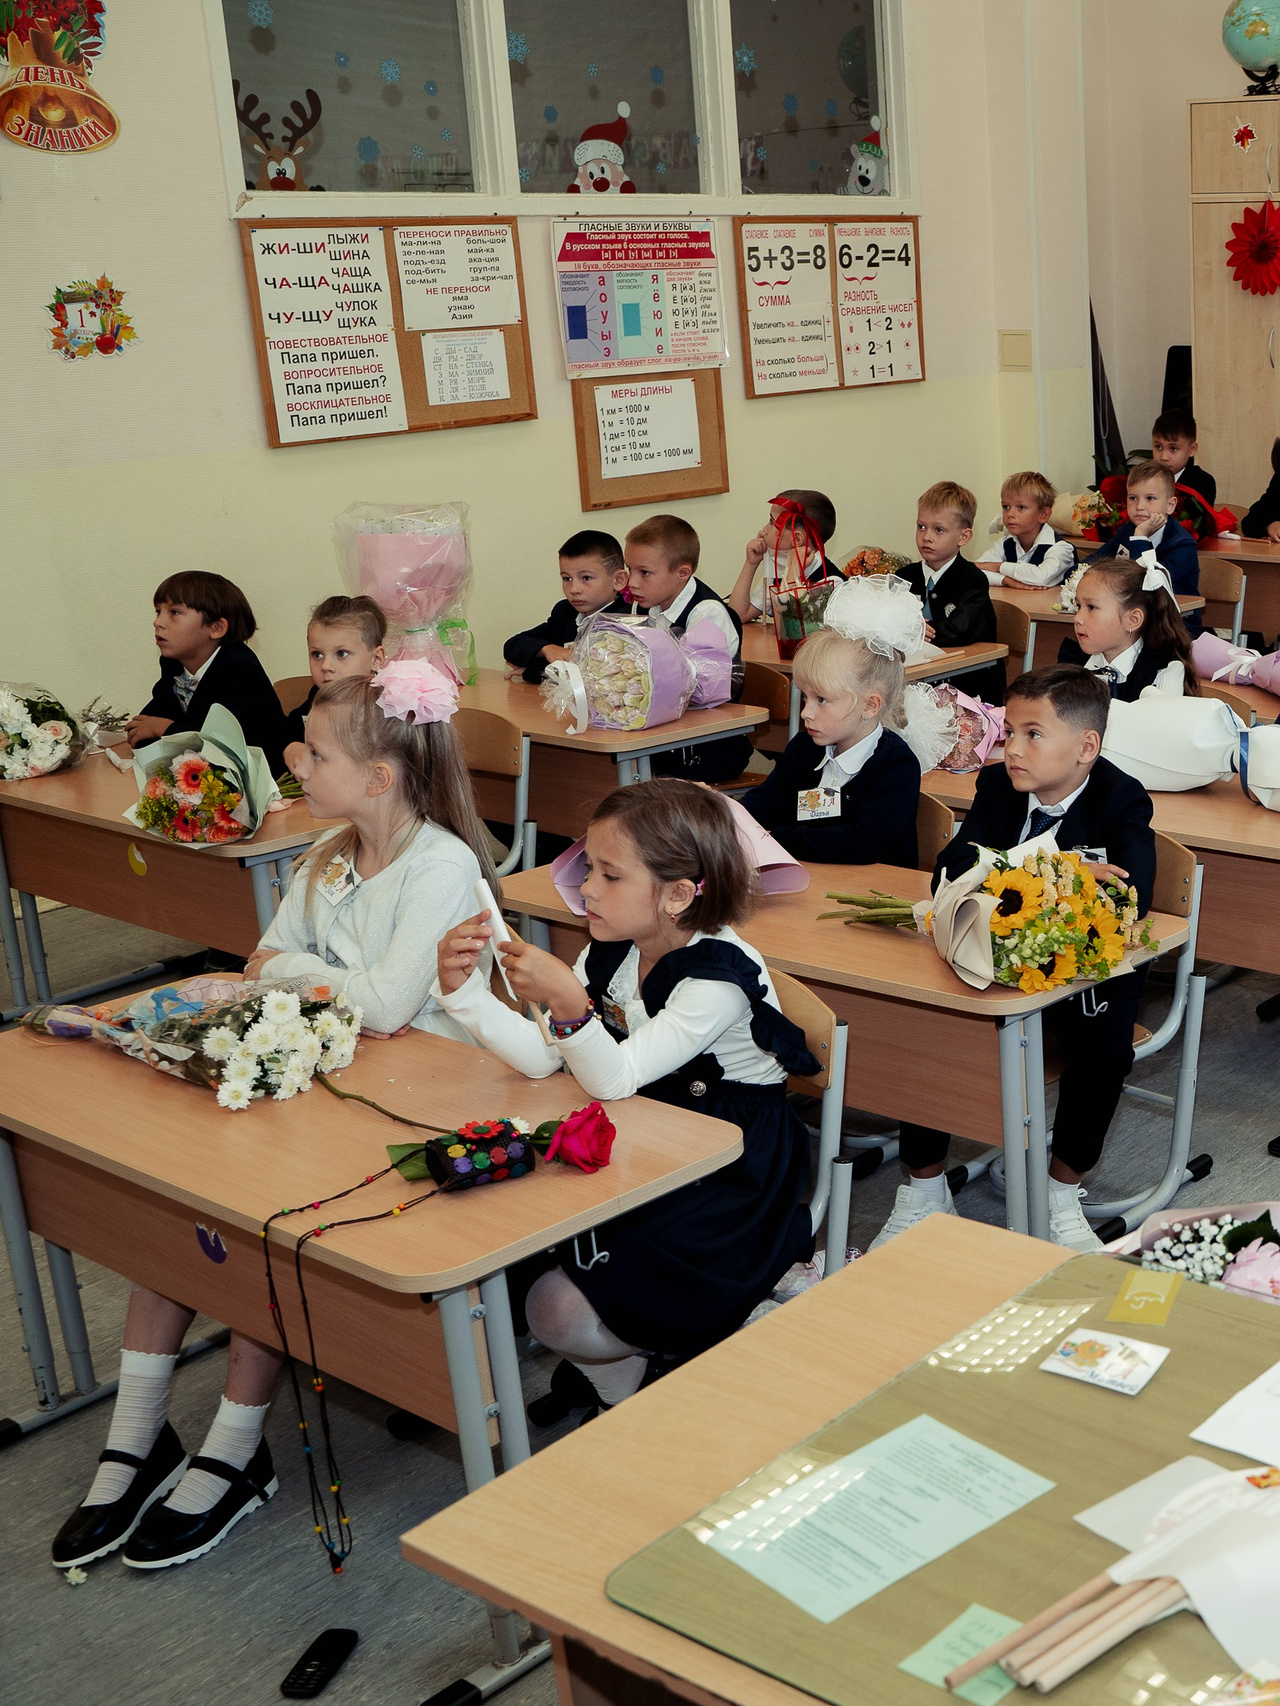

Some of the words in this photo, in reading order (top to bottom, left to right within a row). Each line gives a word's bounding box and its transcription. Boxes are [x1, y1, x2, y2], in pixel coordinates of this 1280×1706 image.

[9, 65, 86, 91] ДЕНЬ
[6, 114, 112, 151] ЗНАНИЙ
[579, 223, 623, 231] ГЛАСНЫЕ
[625, 223, 652, 231] ЗВУКИ
[662, 223, 692, 231] БУКВЫ
[809, 228, 825, 237] СУММА
[328, 233, 369, 244] ЛЫЖИ
[399, 230, 451, 238] ПЕРЕНОСИ
[454, 229, 508, 237] ПРАВИЛЬНО
[466, 237, 506, 245] боль-шой
[573, 243, 600, 251] русском
[260, 242, 326, 255] ЖИ-ШИ
[329, 250, 370, 261] ШИНА
[470, 266, 500, 274] груп-па
[603, 262, 652, 270] обозначающих
[331, 267, 371, 279] ЧАЩА
[470, 274, 513, 282] за-кри-чал
[264, 276, 330, 289] ЧА-ЩА
[332, 282, 382, 294] ЧАШКА
[441, 285, 490, 294] ПЕРЕНОСИ
[844, 290, 878, 301] РАЗНОСТЬ
[336, 300, 378, 311] ЧУЛОК
[758, 295, 791, 307] СУММА
[448, 304, 475, 312] узнаю
[841, 304, 887, 317] СРАВНЕНИЕ
[888, 303, 913, 313] ЧИСЕЛ
[78, 308, 85, 327] 1
[268, 310, 333, 323] ЧУ-ЩУ
[338, 316, 377, 329] ЩУКА
[752, 321, 785, 330] Увеличить
[800, 318, 822, 327] единиц
[268, 333, 389, 350] ПОВЕСТВОВАТЕЛЬНОЕ
[753, 337, 786, 345] Уменьшить
[801, 333, 823, 342] единиц
[281, 352, 317, 364] Папа
[322, 348, 379, 364] пришел.
[755, 358, 765, 367] На
[767, 356, 795, 365] сколько
[797, 354, 824, 363] больше
[284, 364, 384, 380] ВОПРОСИТЕЛЬНОЕ
[757, 372, 767, 380] На
[769, 370, 797, 379] сколько
[799, 368, 826, 376] меньше
[286, 383, 322, 396] Папа
[326, 375, 387, 394] пришел?
[611, 388, 638, 398] МЕРЫ
[640, 385, 673, 397] ДЛИНЫ
[287, 394, 392, 412] ВОСКЛИЦАТЕЛЬНОЕ
[600, 408, 604, 416] 1
[625, 404, 642, 413] 1000
[290, 414, 326, 427] Папа
[330, 406, 388, 425] пришел!
[626, 417, 634, 425] 10
[637, 417, 647, 425] дм
[627, 429, 635, 438] 10
[628, 442, 637, 450] 10
[630, 453, 642, 461] 100
[645, 452, 655, 460] см
[664, 448, 681, 457] 1000
